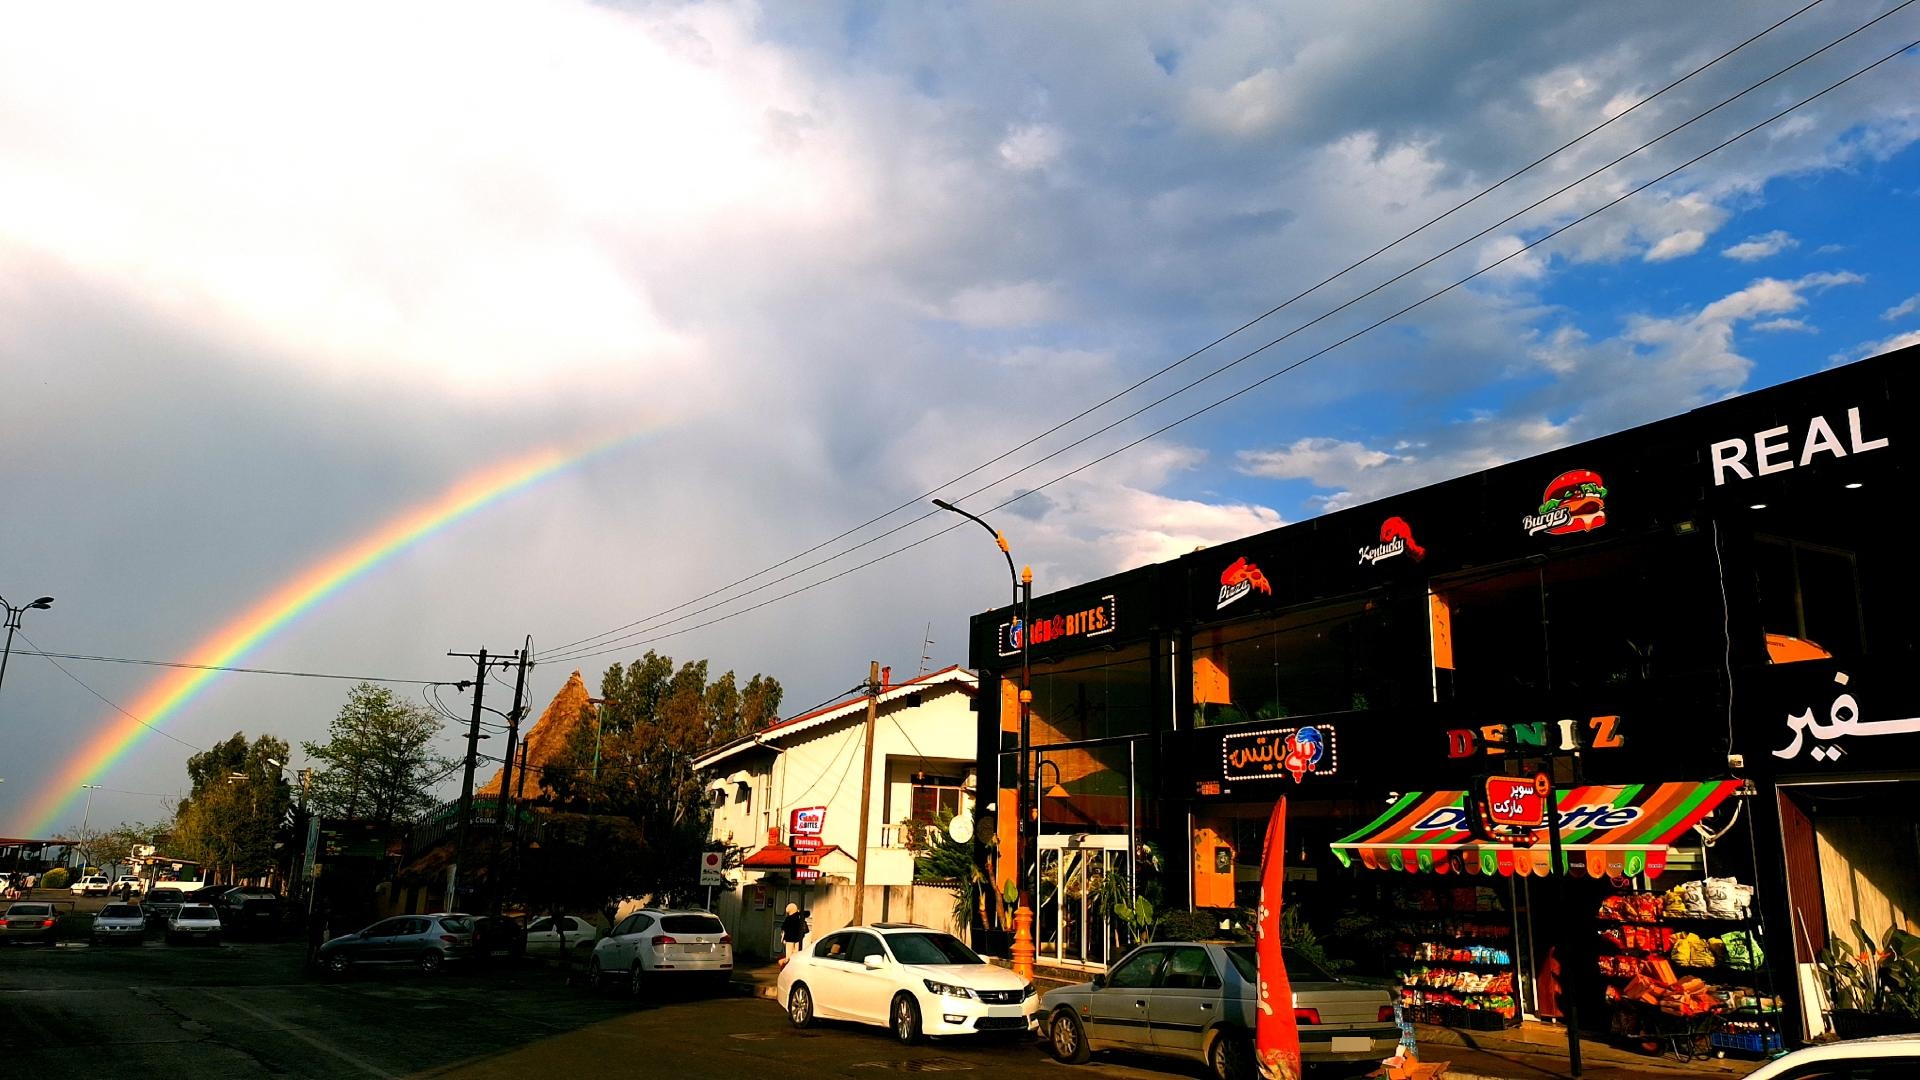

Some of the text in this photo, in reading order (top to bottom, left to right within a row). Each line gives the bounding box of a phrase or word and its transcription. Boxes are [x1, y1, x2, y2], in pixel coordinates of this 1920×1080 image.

[1710, 407, 1889, 486] REAL
[1522, 507, 1569, 536] Burger
[1358, 535, 1404, 565] Kentucky
[1217, 579, 1250, 610] Pizza
[1772, 672, 1920, 761] فیر
[1446, 715, 1624, 759] DENIZ
[1510, 784, 1534, 799] سوپر
[1493, 800, 1523, 818] مارکت
